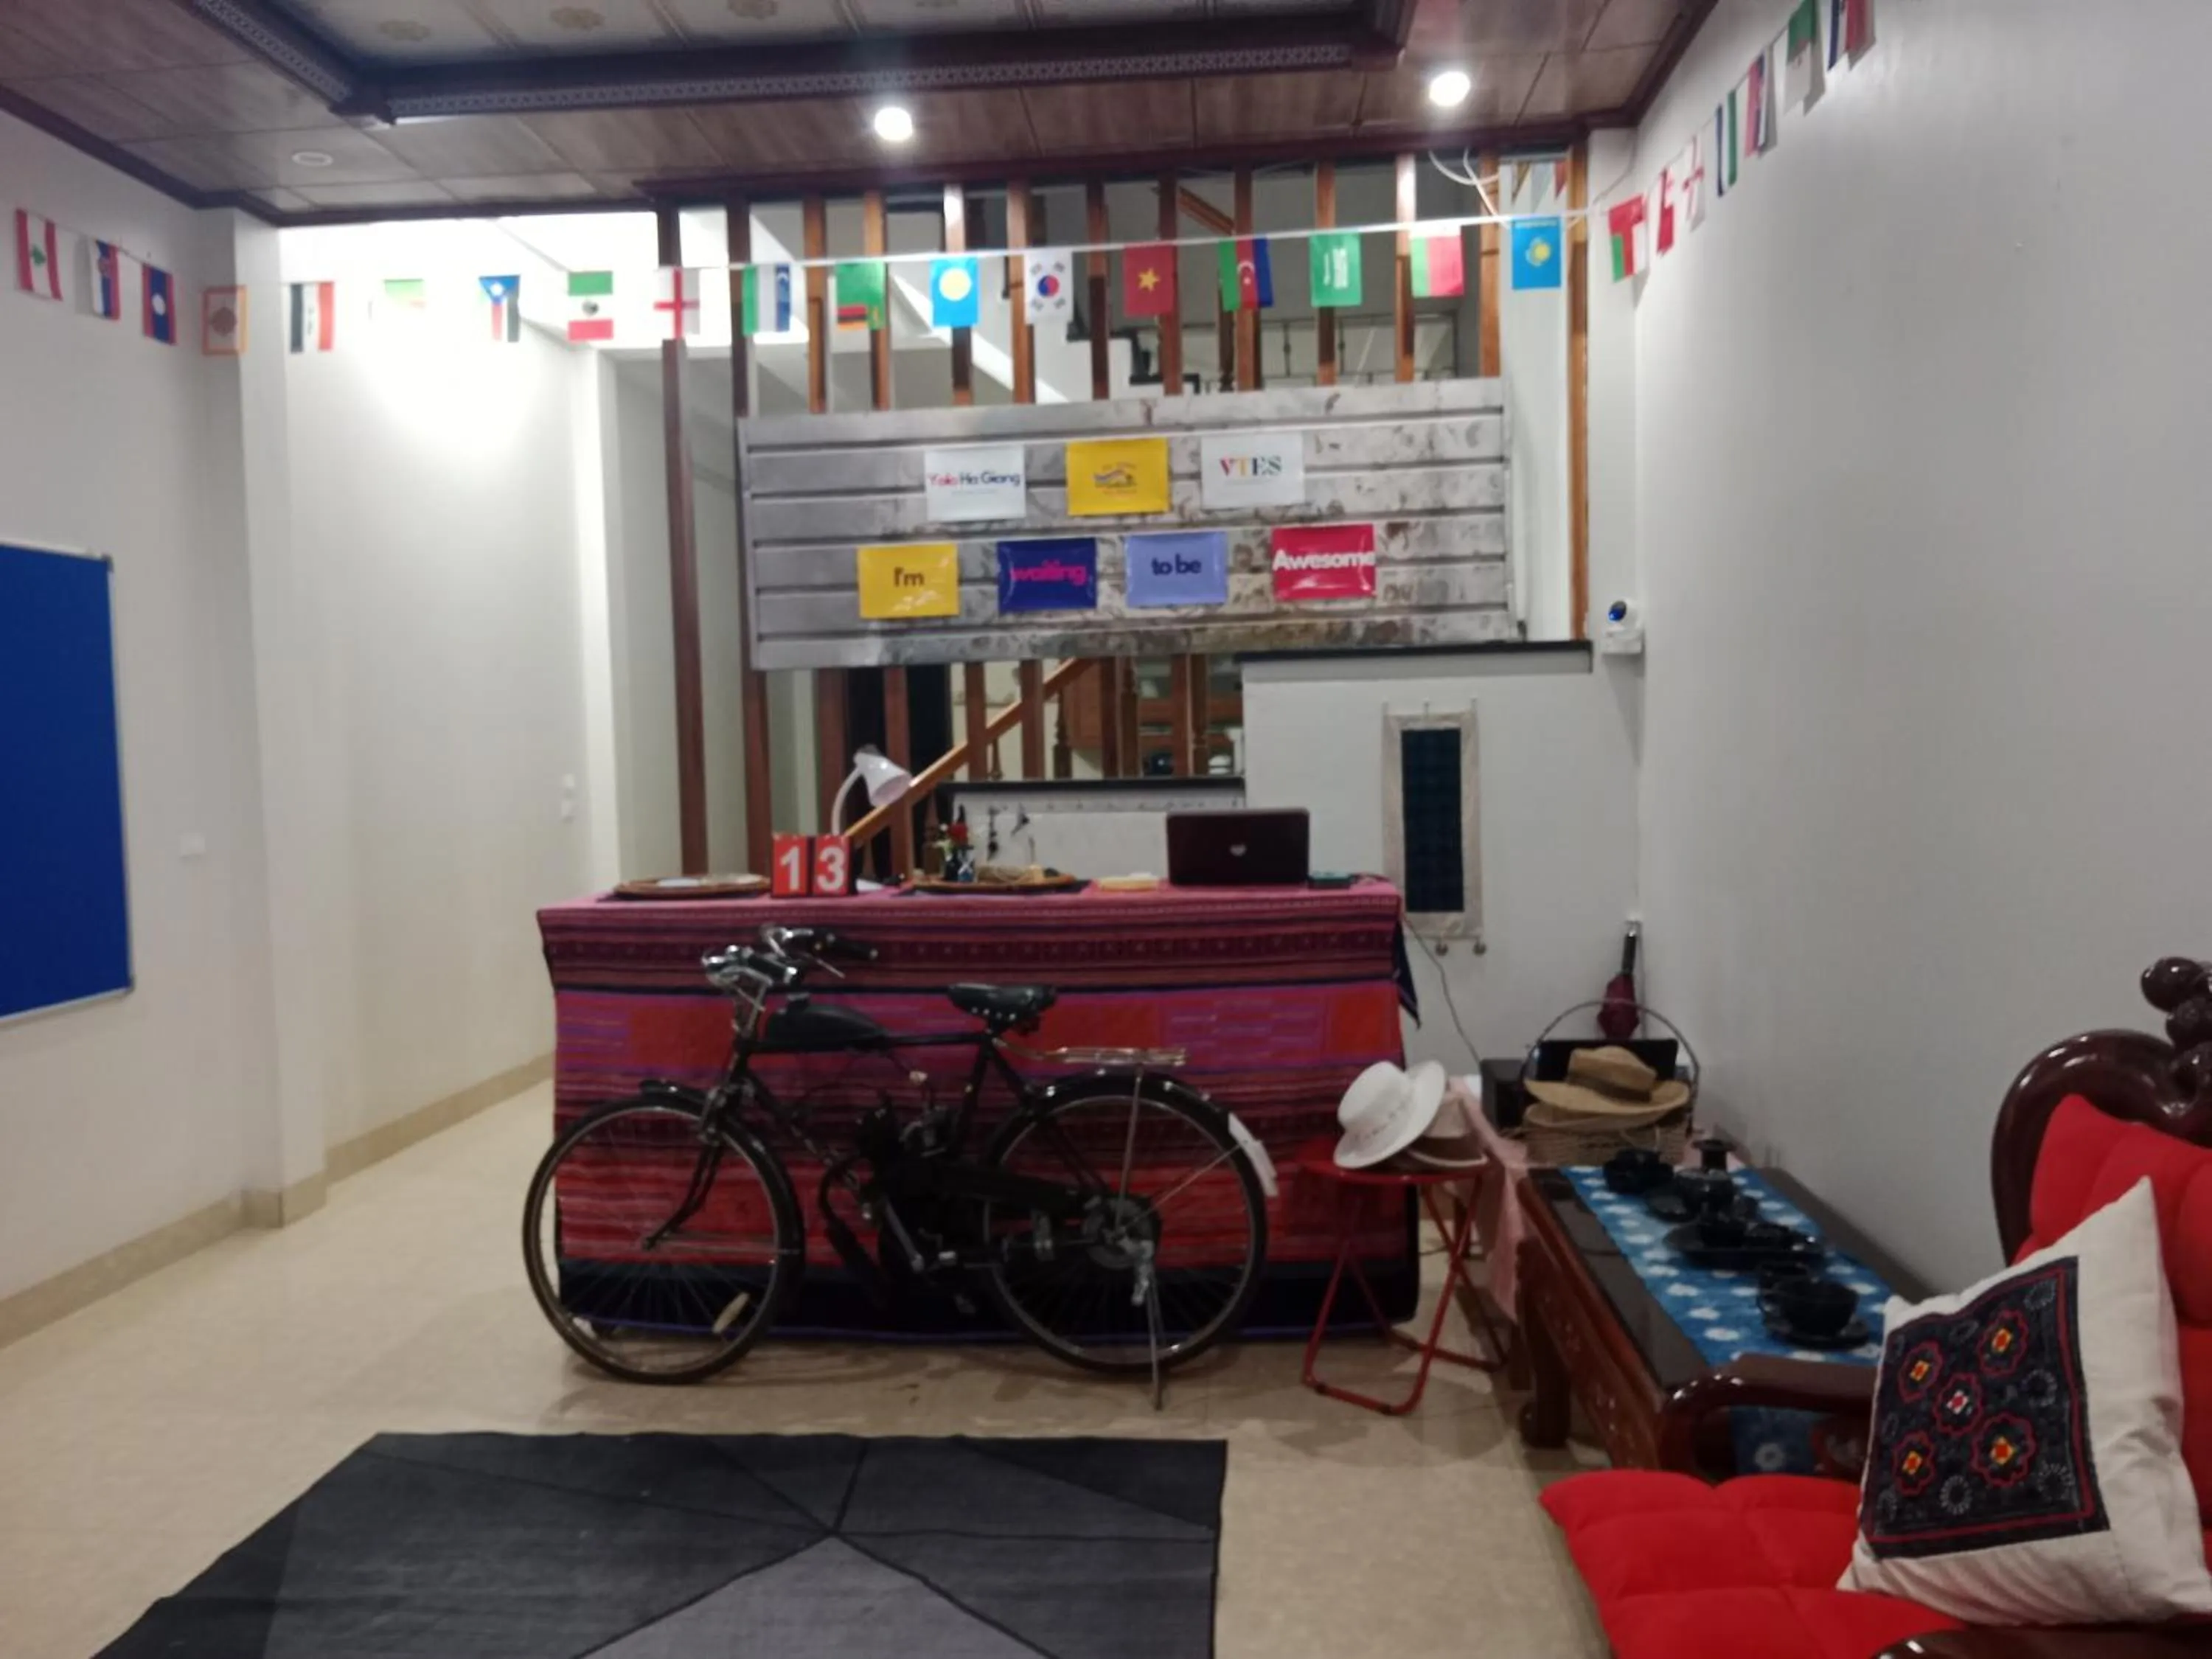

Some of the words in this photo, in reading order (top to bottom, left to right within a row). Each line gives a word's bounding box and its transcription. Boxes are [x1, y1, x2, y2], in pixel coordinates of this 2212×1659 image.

[1151, 557, 1172, 575] to
[1175, 553, 1202, 574] be
[894, 566, 925, 587] I'm
